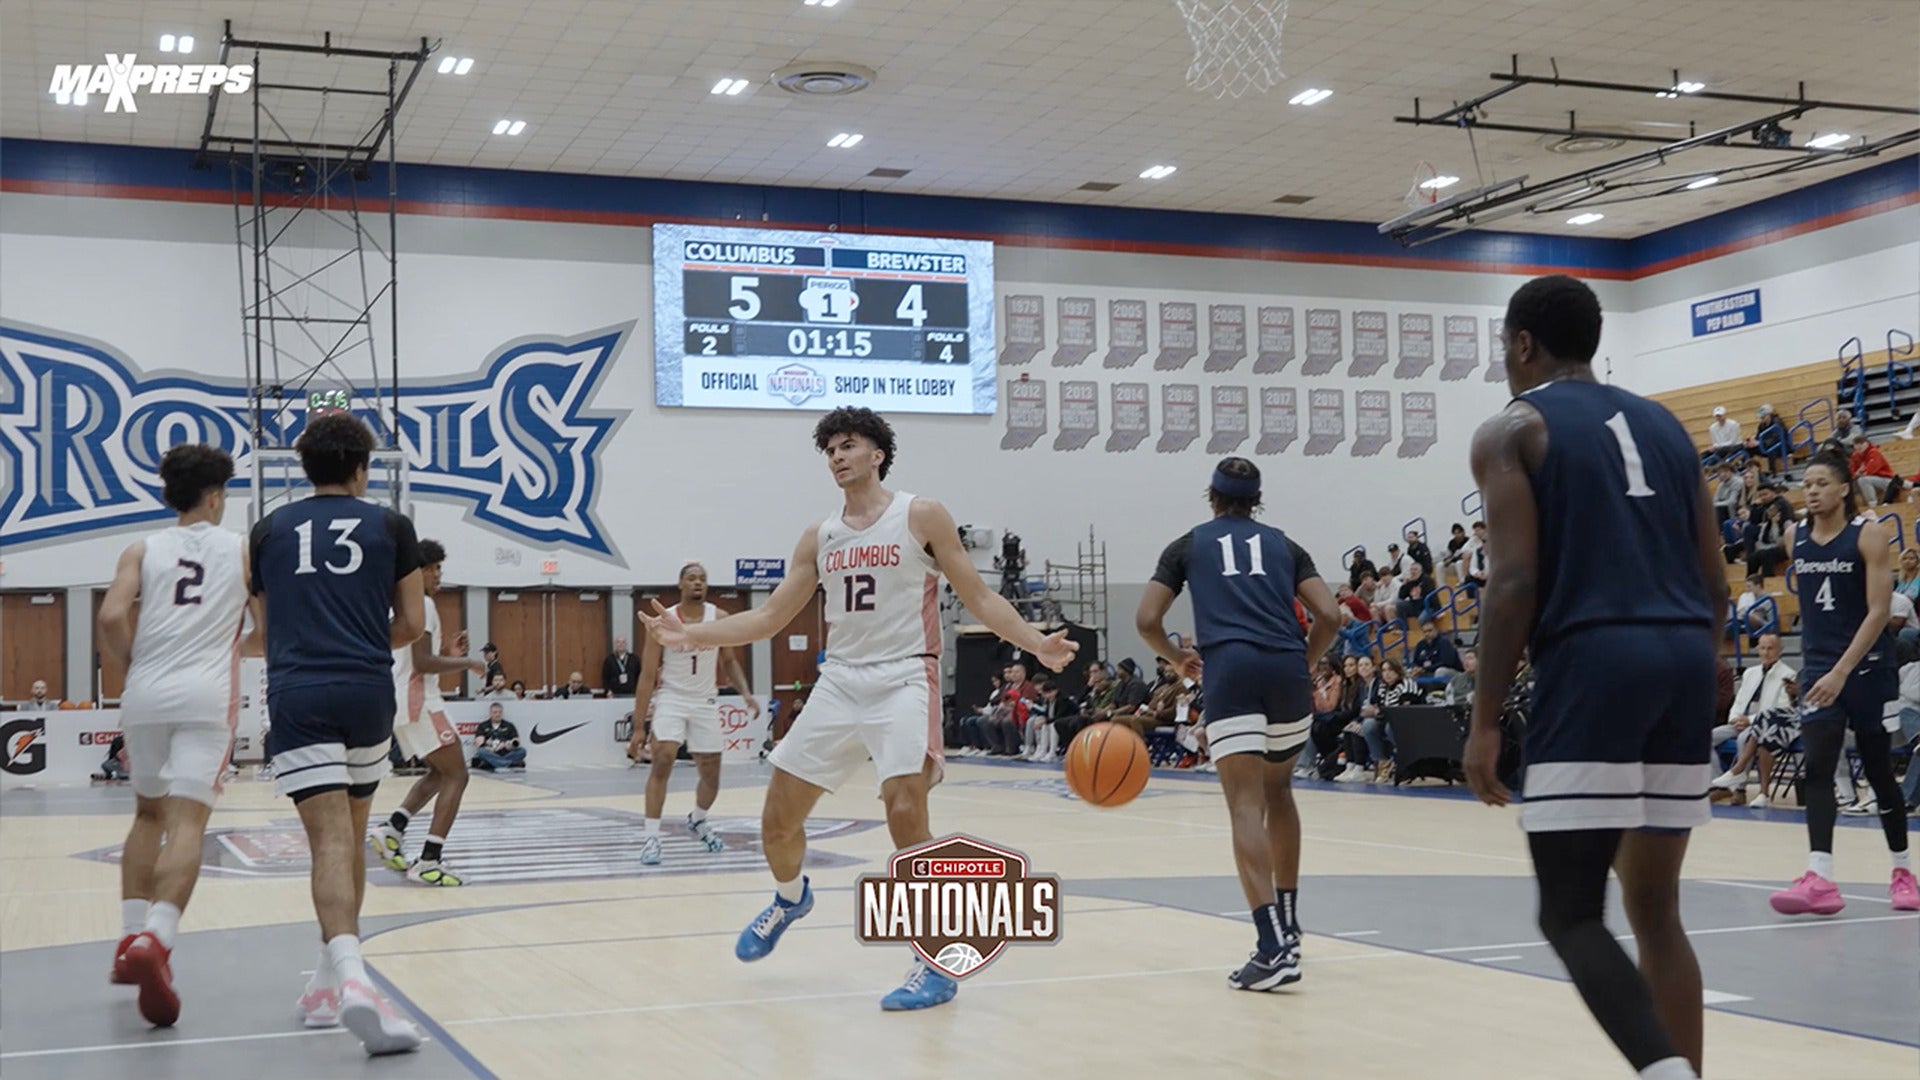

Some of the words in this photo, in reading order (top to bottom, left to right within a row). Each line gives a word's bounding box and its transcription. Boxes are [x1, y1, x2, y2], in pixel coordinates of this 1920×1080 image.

[686, 243, 796, 264] COLUMBUS
[867, 252, 966, 273] BREWSTER
[729, 276, 761, 320] 5
[810, 281, 848, 290] PERIOD
[821, 294, 838, 317] 1
[896, 284, 928, 327] 4
[1695, 292, 1756, 318] SOUTHEASTERN
[689, 324, 729, 334] FOULS
[926, 332, 964, 342] FOULS
[702, 336, 717, 355] 2
[788, 329, 872, 357] 01:15
[939, 344, 953, 363] 4
[701, 372, 758, 391] OFFICIAL
[835, 376, 869, 394] SHOP
[873, 378, 886, 394] IN
[890, 378, 912, 395] THE
[916, 379, 955, 397] LOBBY
[1604, 410, 1656, 497] 1
[294, 518, 364, 575] 13
[825, 543, 901, 573] COLUMBUS
[1217, 533, 1267, 577] 11
[1794, 558, 1854, 575] Brewster
[174, 558, 204, 606] 2
[844, 574, 876, 612] 12
[1815, 576, 1836, 612] 4
[691, 655, 697, 675] 1
